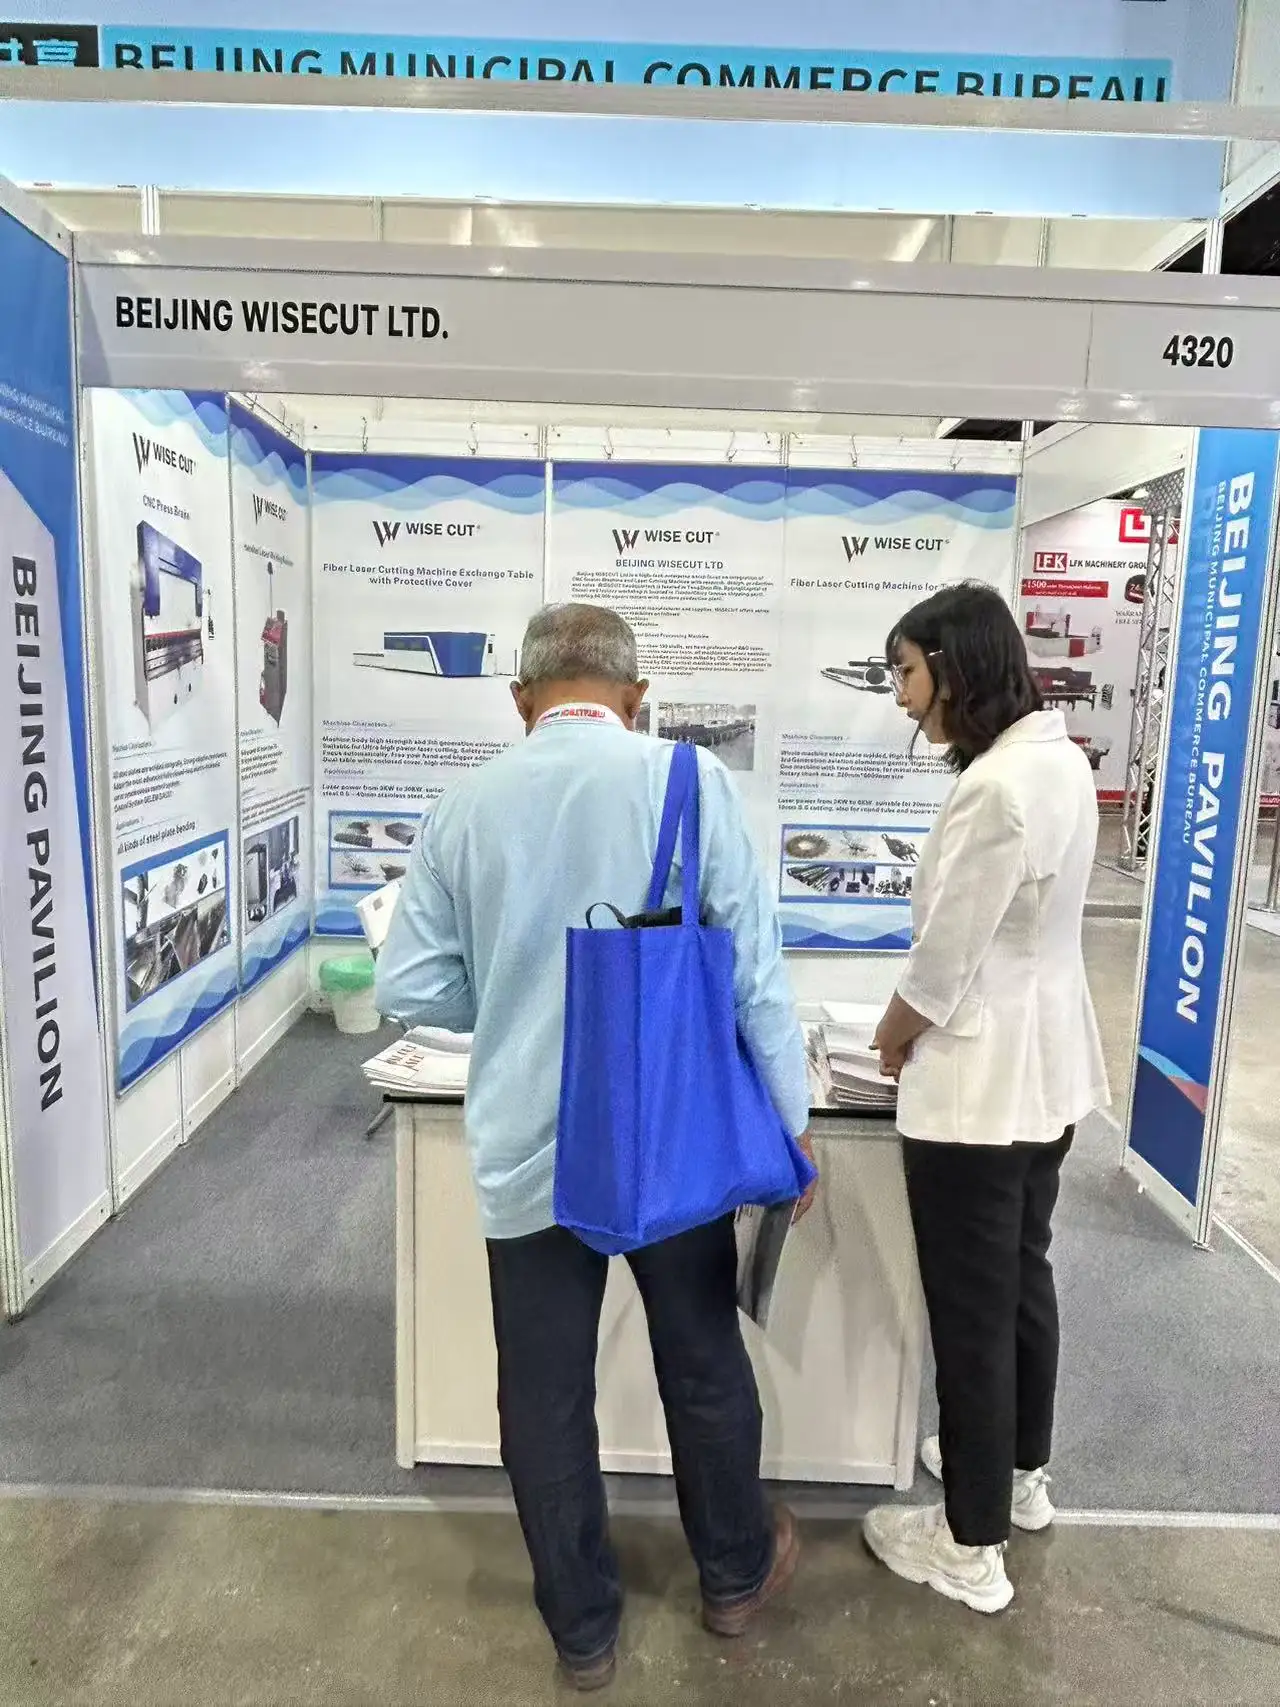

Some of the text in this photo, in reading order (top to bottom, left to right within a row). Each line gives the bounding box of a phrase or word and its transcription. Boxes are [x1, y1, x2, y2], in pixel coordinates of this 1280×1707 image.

[116, 296, 448, 339] BEIJING WISECUT LTD.
[1163, 335, 1233, 368] 4320
[153, 442, 177, 468] WISE
[178, 454, 194, 475] CUT
[406, 523, 442, 535] WISE
[447, 524, 475, 537] CUT
[644, 530, 681, 543] WISE
[685, 531, 713, 544] CUT
[874, 537, 911, 550] WISE
[915, 539, 943, 551] CUT
[615, 559, 724, 570] BEIJING WISECUT LTD
[1036, 553, 1066, 571] LFK
[1069, 559, 1083, 568] LFK
[1085, 560, 1127, 569] MACHINERY
[323, 564, 534, 580] Fiber Laser Cutting Machine Exchange Table
[369, 577, 473, 587] with Protective Cover
[790, 578, 815, 588] Fiber
[817, 579, 842, 588] Laser
[844, 581, 880, 591] Cutting
[882, 581, 923, 591] Machine
[925, 582, 938, 591] for
[1183, 479, 1227, 844] BEIJING MUNICIPAL COMMERCE BUREAU
[1175, 471, 1255, 1024] BEIJING PAVILION
[12, 556, 62, 1111] BEIJING PAVILION
